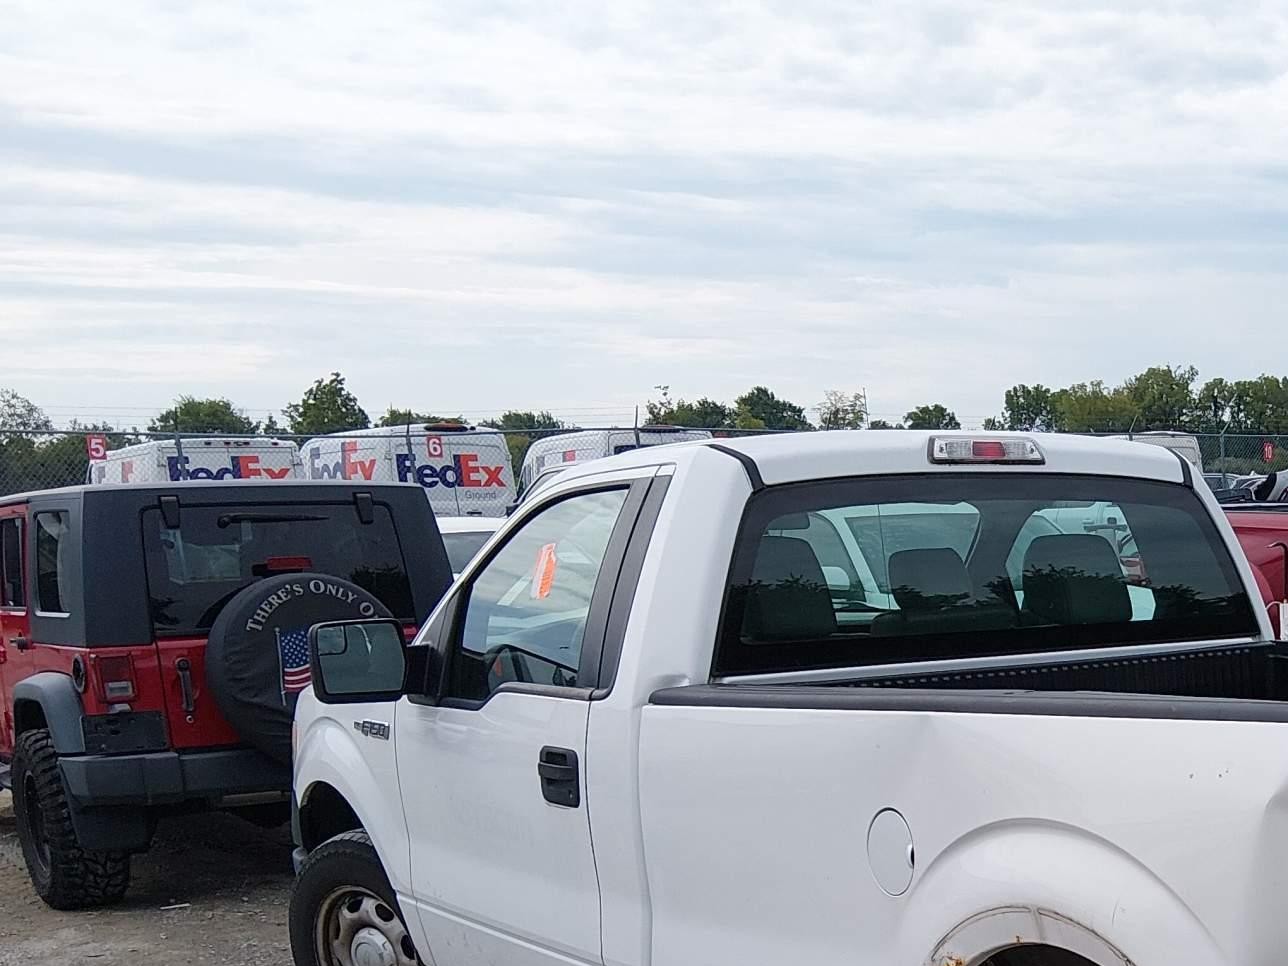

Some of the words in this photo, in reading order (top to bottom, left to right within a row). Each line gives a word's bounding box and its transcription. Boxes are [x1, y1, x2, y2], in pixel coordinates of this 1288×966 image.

[90, 438, 105, 457] 5
[428, 438, 441, 456] 6
[396, 453, 506, 488] FedEx
[465, 490, 497, 500] Ground
